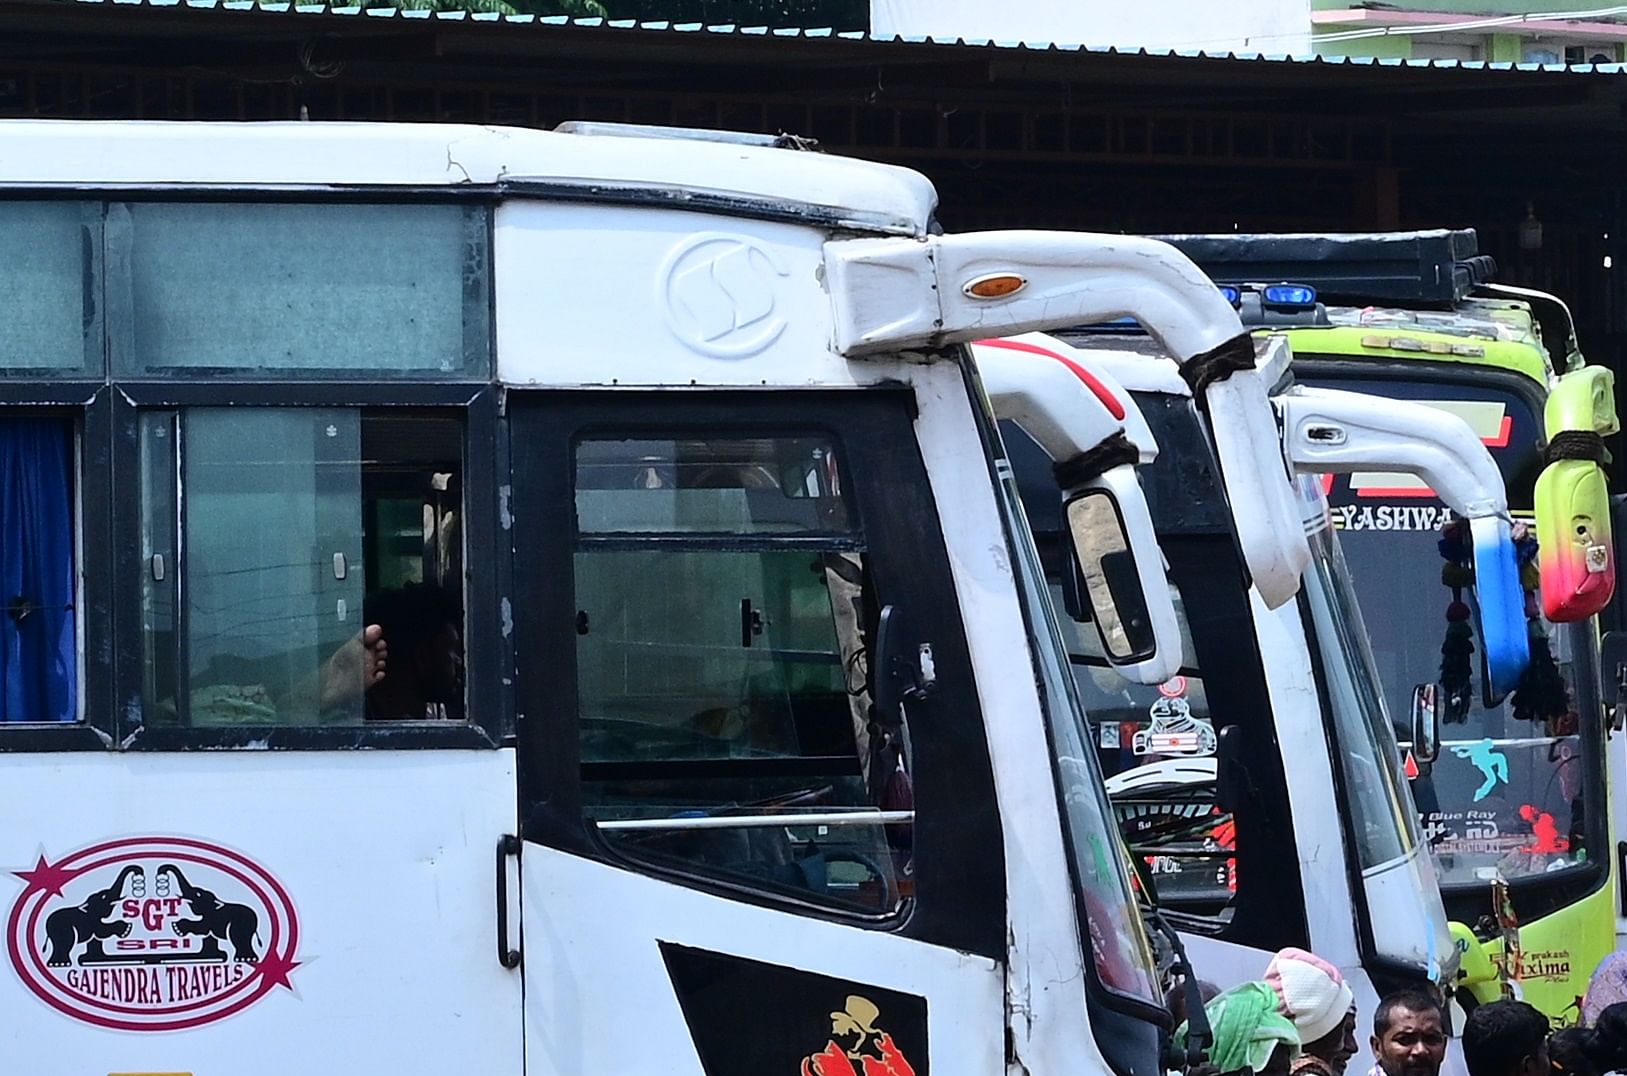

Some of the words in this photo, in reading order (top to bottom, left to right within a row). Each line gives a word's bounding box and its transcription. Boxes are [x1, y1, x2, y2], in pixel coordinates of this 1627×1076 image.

[1466, 809, 1497, 821] Ray
[116, 938, 191, 951] SRI
[67, 967, 161, 1004] GAJENDRA
[165, 963, 244, 1003] TRAVELS
